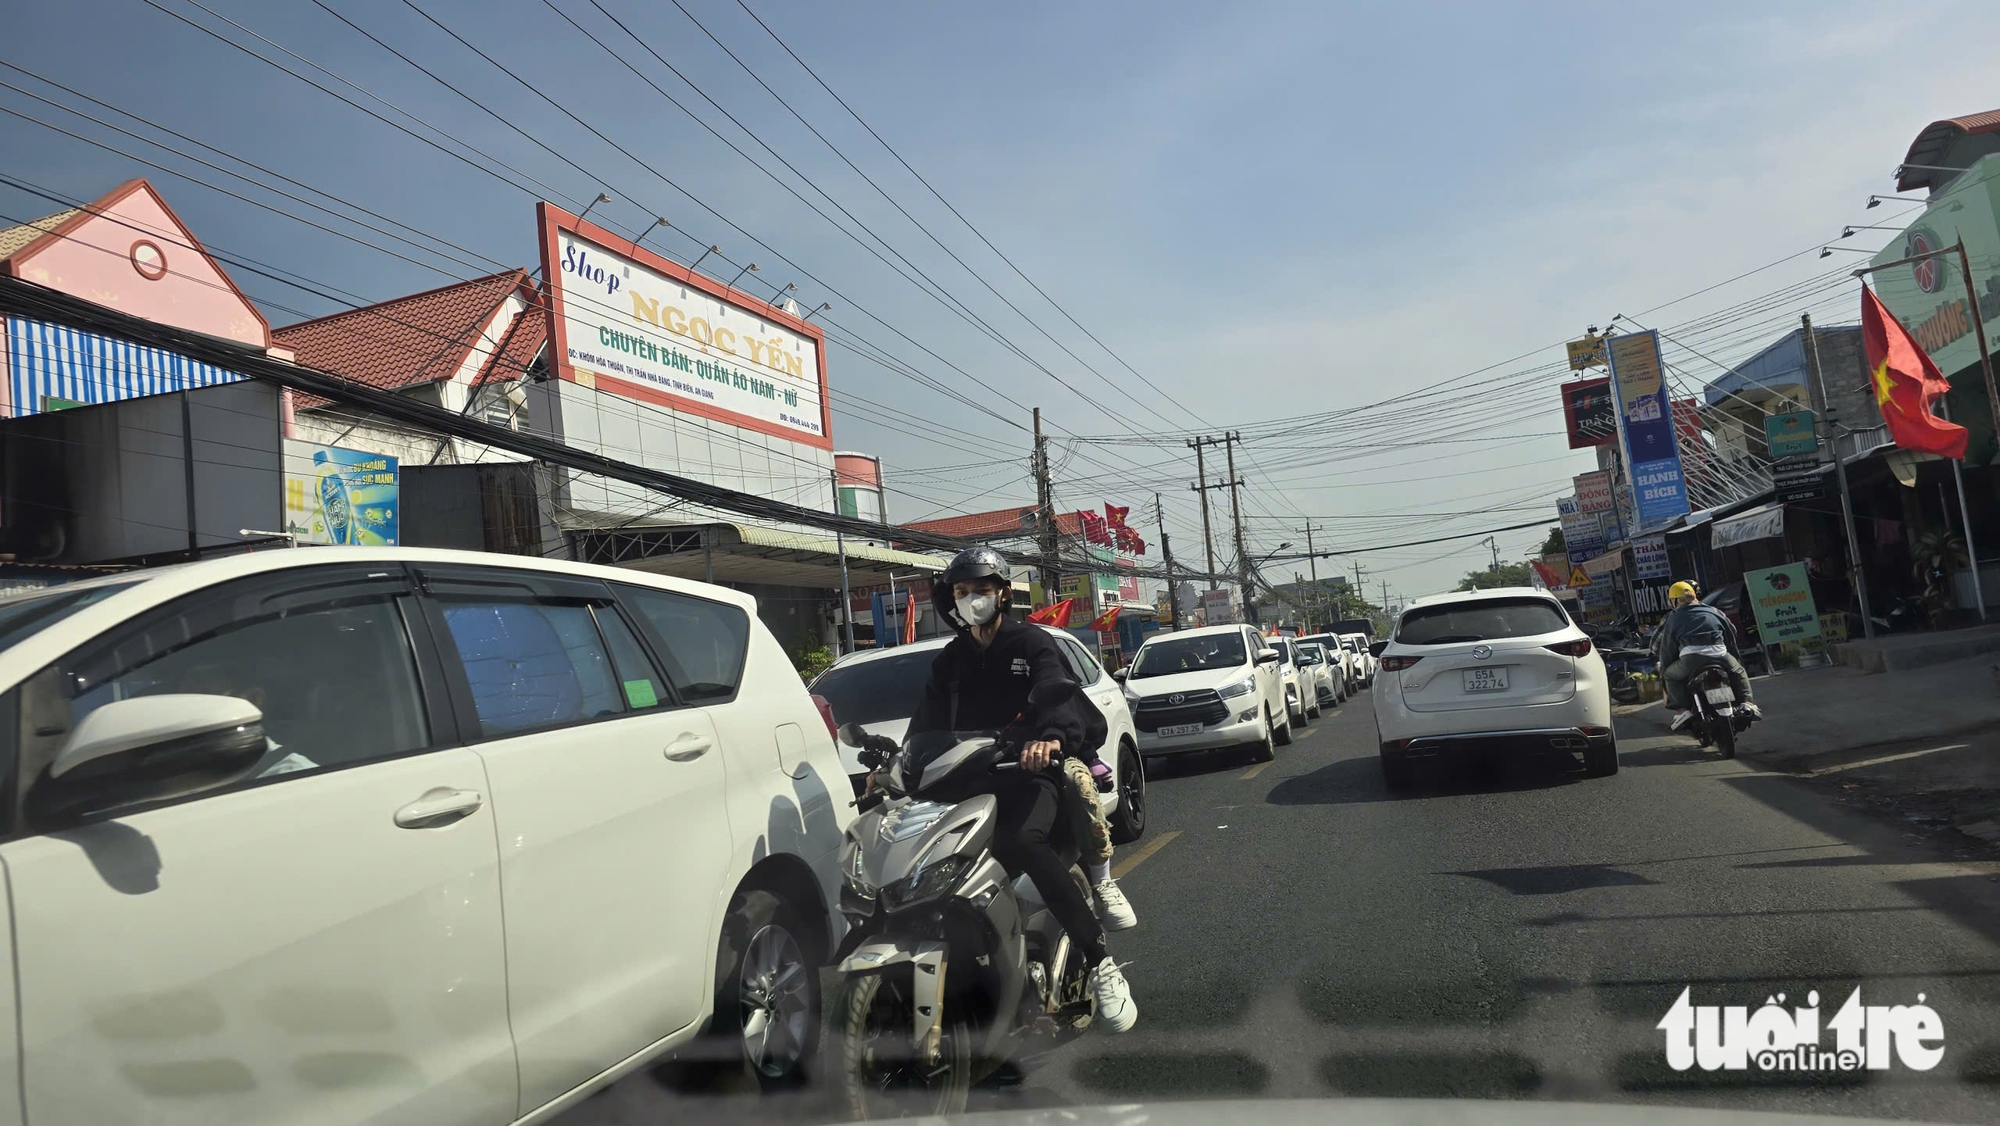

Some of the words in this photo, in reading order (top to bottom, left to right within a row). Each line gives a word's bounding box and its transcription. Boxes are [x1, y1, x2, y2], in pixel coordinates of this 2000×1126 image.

[561, 245, 622, 295] Shop
[629, 290, 736, 355] NGỌC
[600, 325, 657, 362] CHUYÊN
[661, 346, 693, 374] BÁN:
[733, 368, 747, 391] ÁO
[750, 377, 775, 400] NAM
[1637, 470, 1679, 486] HẠNH
[1644, 485, 1678, 500] BÍCH
[1635, 580, 1659, 613] RỬA
[1775, 606, 1797, 617] Fruit
[1475, 670, 1495, 679] 65A
[1468, 678, 1504, 690] 322.74
[1161, 725, 1200, 736] 67A-297.26
